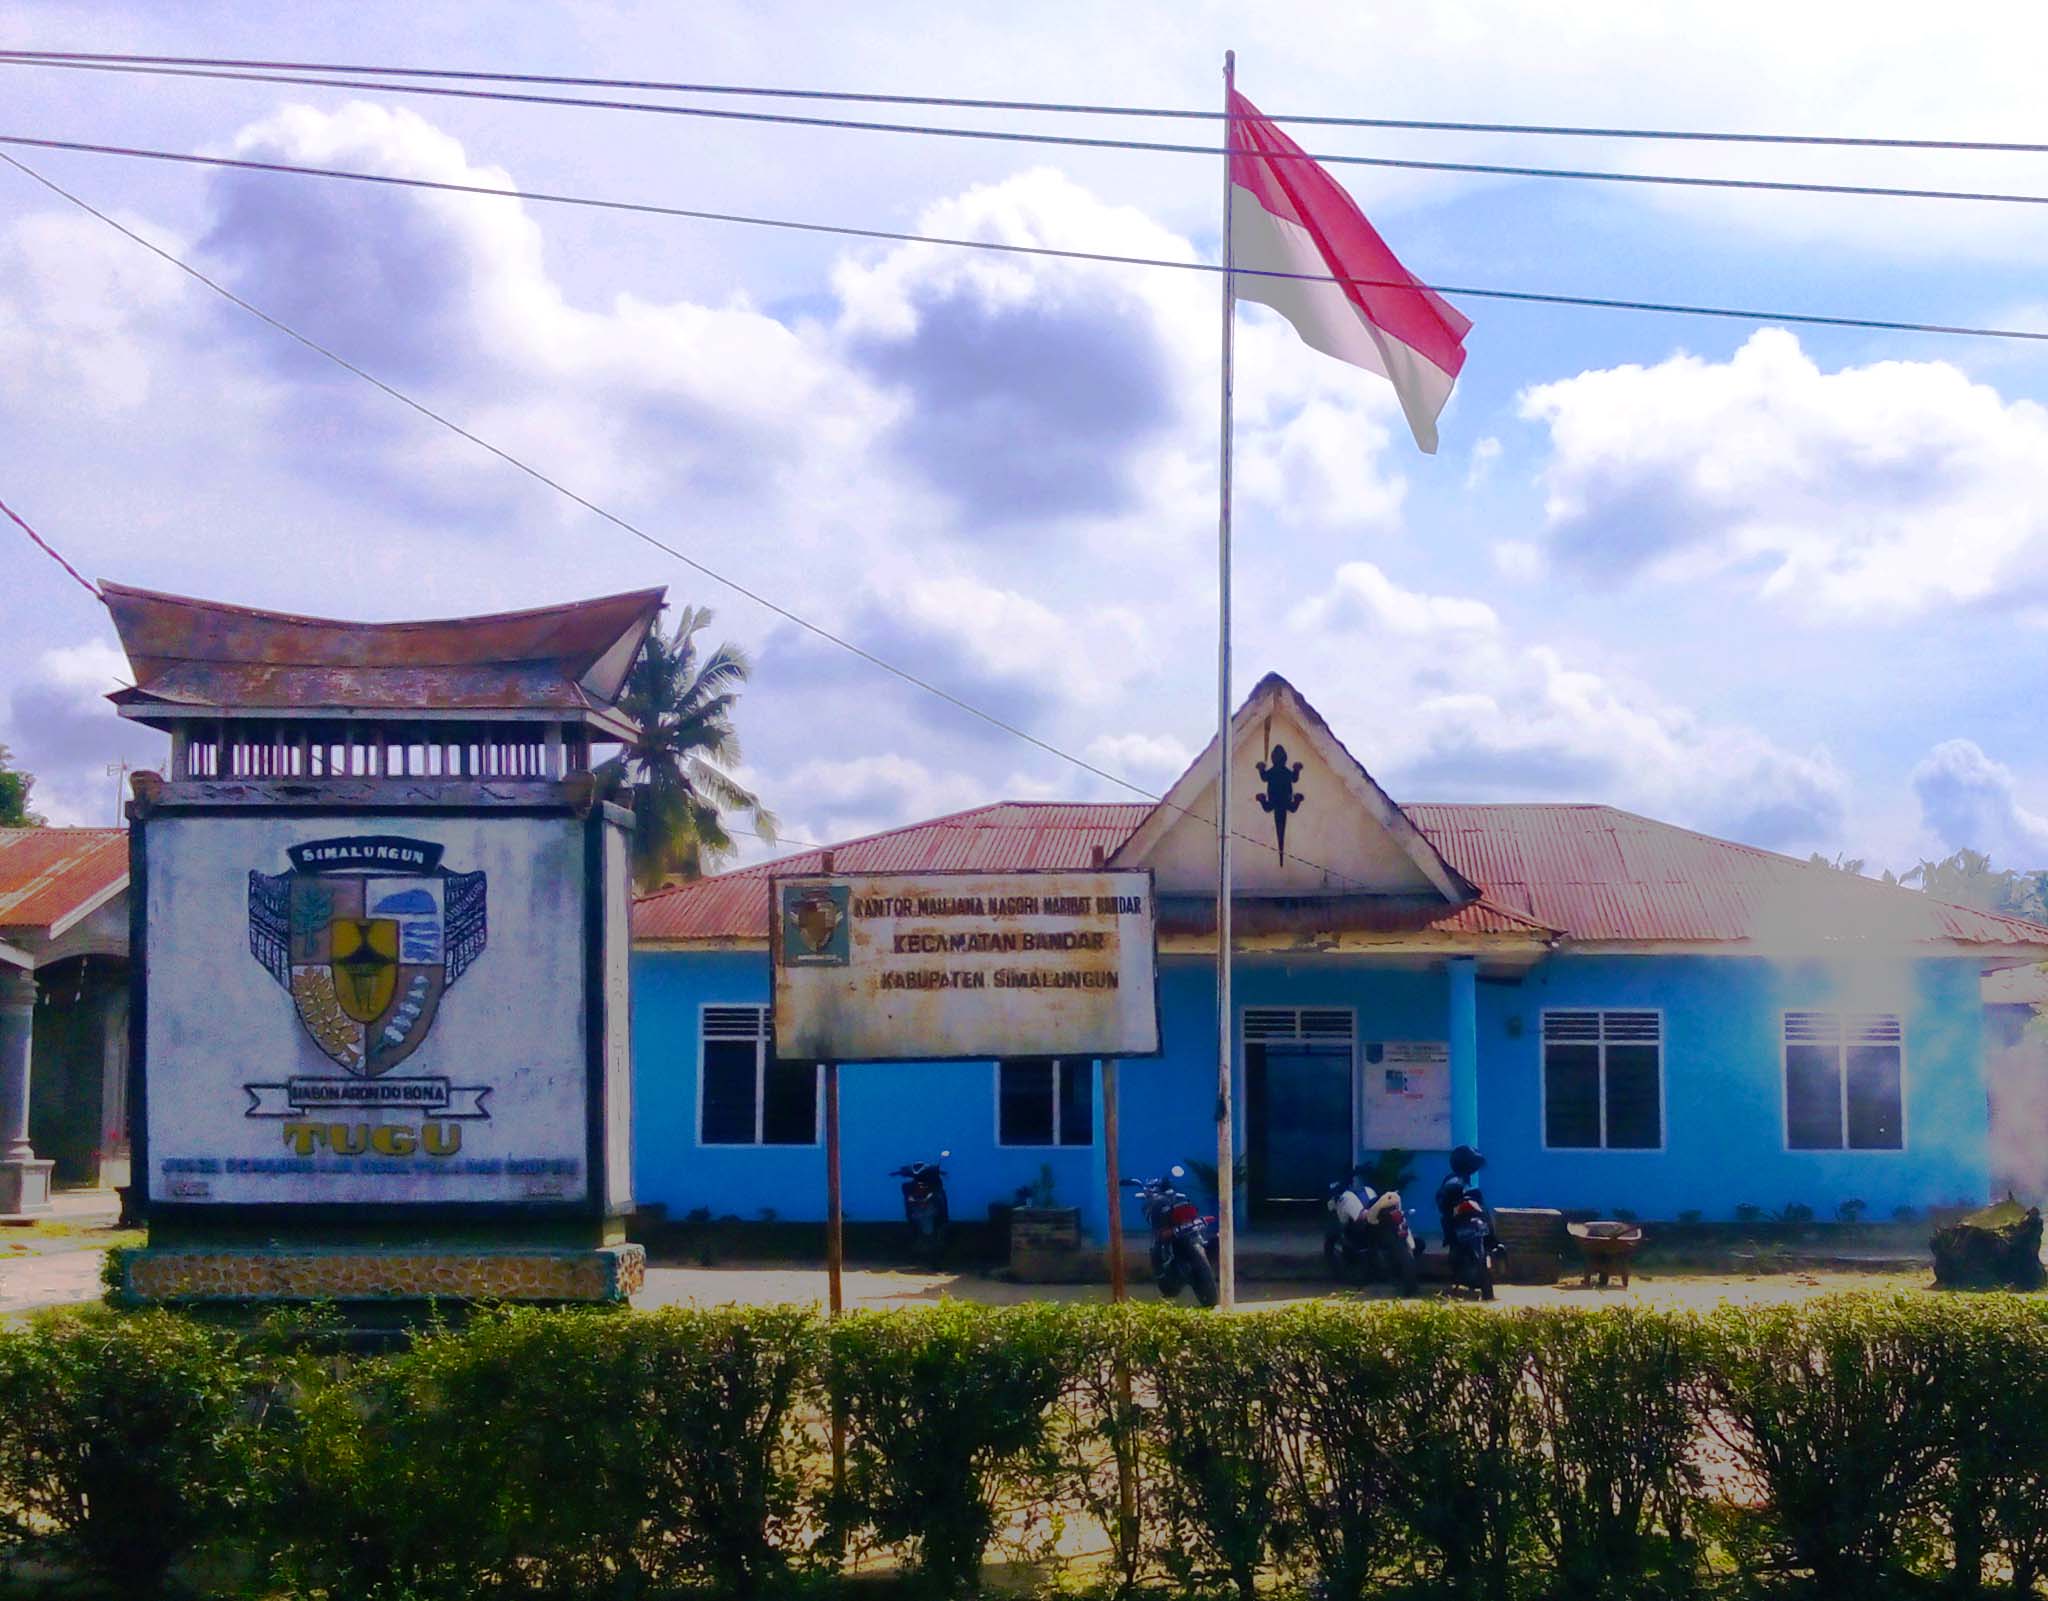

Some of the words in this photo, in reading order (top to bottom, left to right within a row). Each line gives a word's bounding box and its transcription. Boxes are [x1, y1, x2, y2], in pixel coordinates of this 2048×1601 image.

[302, 846, 424, 865] SIMALUNGUN
[853, 897, 912, 918] KANTOR
[988, 896, 1039, 915] NAGORI
[1097, 896, 1142, 914] BANDAR
[893, 932, 1016, 954] KECAMATAN
[1023, 931, 1105, 950] BANDAR
[881, 970, 985, 990] KABUPATEN
[993, 969, 1119, 989] SIMALUNGUN
[403, 1087, 446, 1100] BONA
[284, 1122, 462, 1156] TUGU
